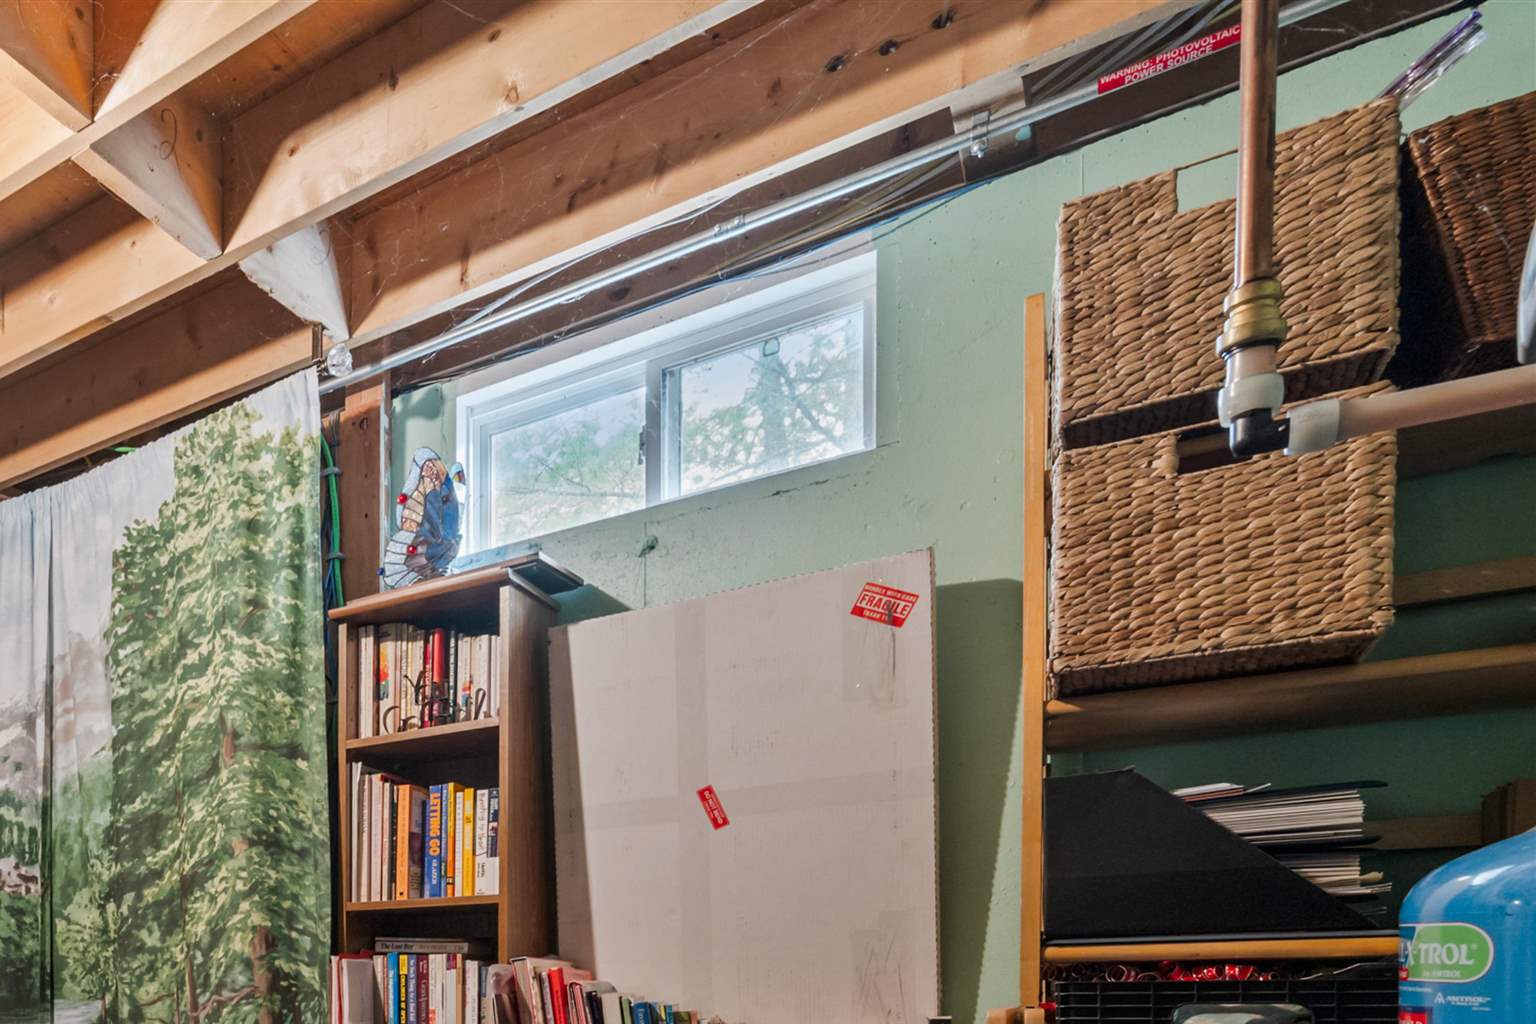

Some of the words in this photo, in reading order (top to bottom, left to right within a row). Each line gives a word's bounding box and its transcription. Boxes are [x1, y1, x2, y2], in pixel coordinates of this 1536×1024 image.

[1099, 58, 1153, 85] WARNING:
[1155, 24, 1241, 64] PHOTOVOLTAIC
[1124, 64, 1165, 85] POWER
[1166, 44, 1214, 69] SOURCE
[429, 792, 441, 837] LETTING
[429, 838, 441, 856] GO
